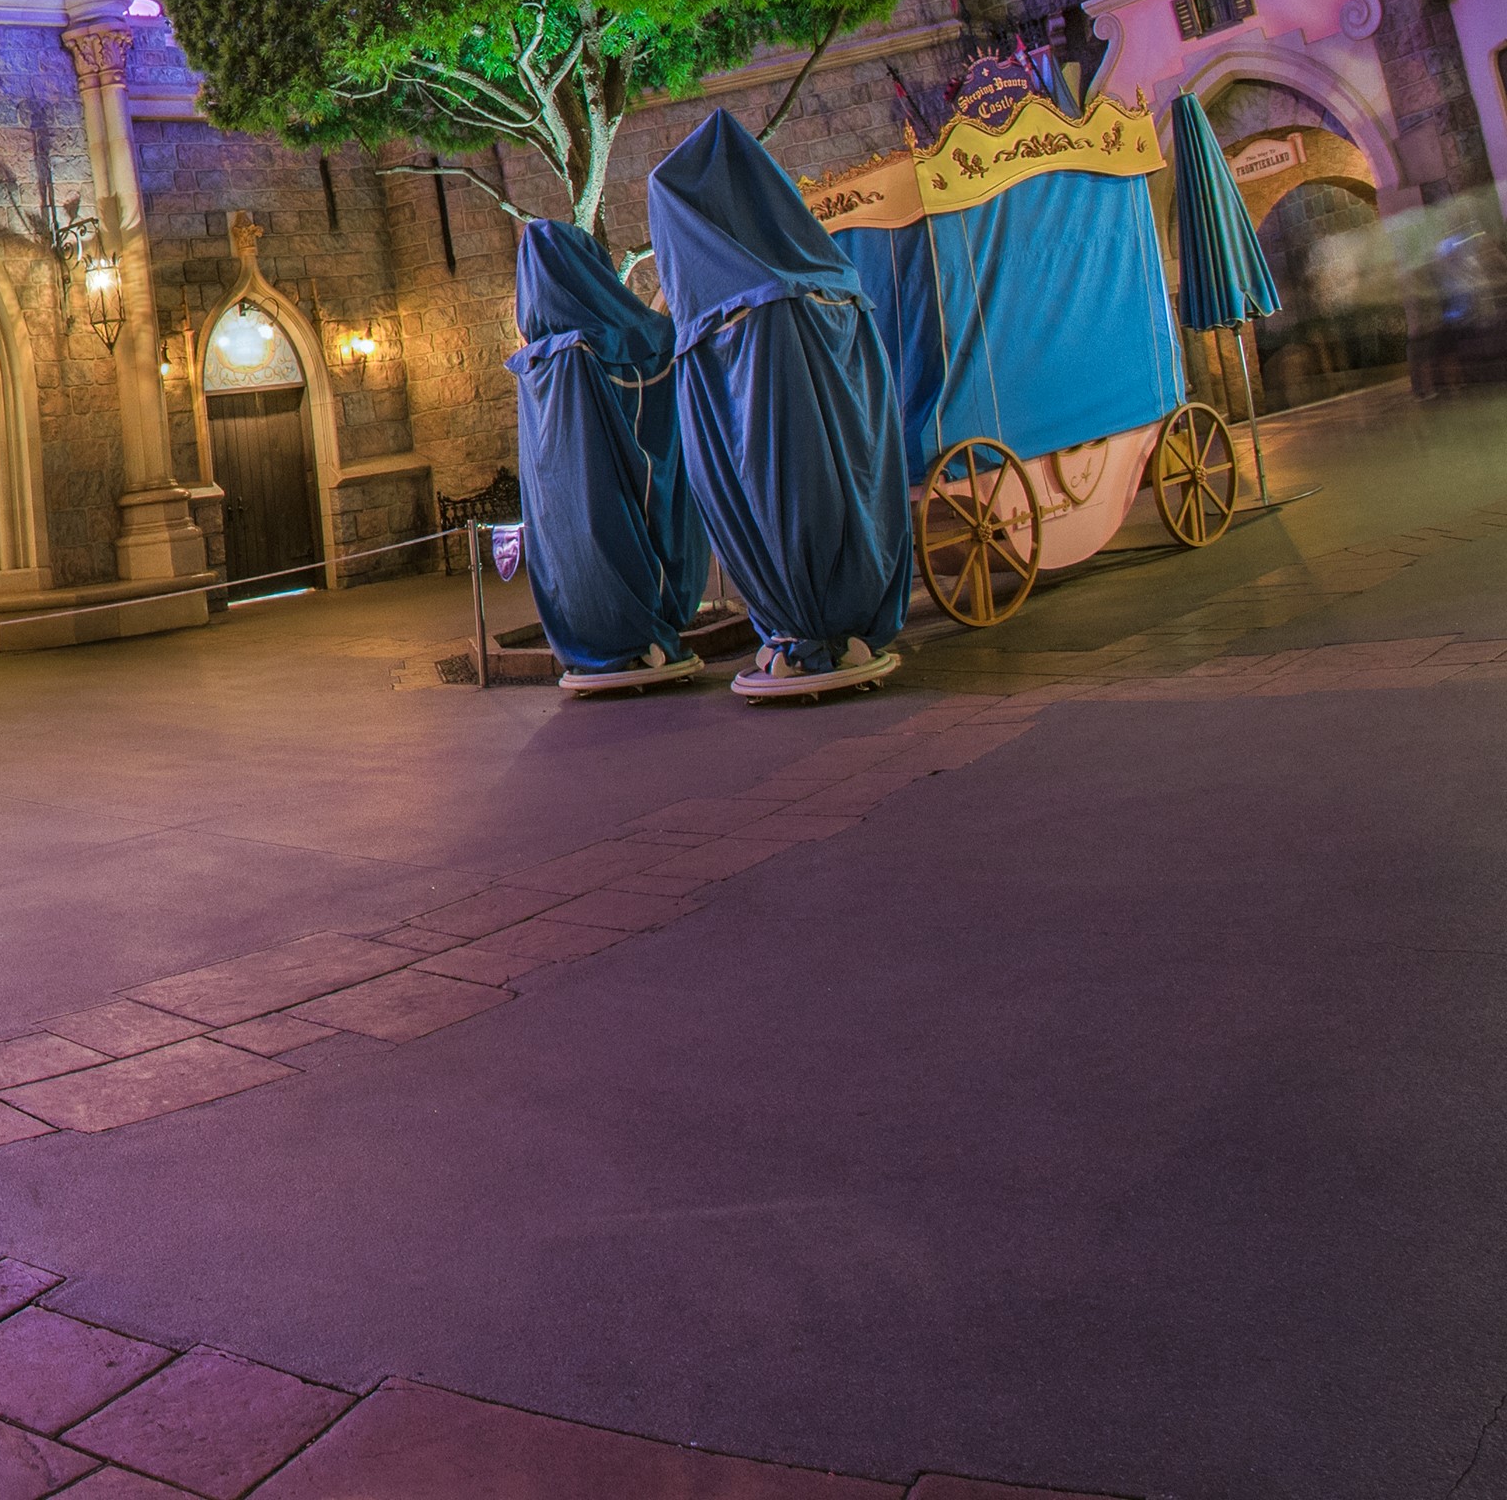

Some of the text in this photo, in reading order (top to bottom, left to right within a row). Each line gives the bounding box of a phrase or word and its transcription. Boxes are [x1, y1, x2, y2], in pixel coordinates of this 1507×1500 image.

[957, 76, 1028, 112] Sleeping Beauty
[978, 95, 1014, 119] Castle
[1235, 151, 1290, 177] FRONTIERLAND
